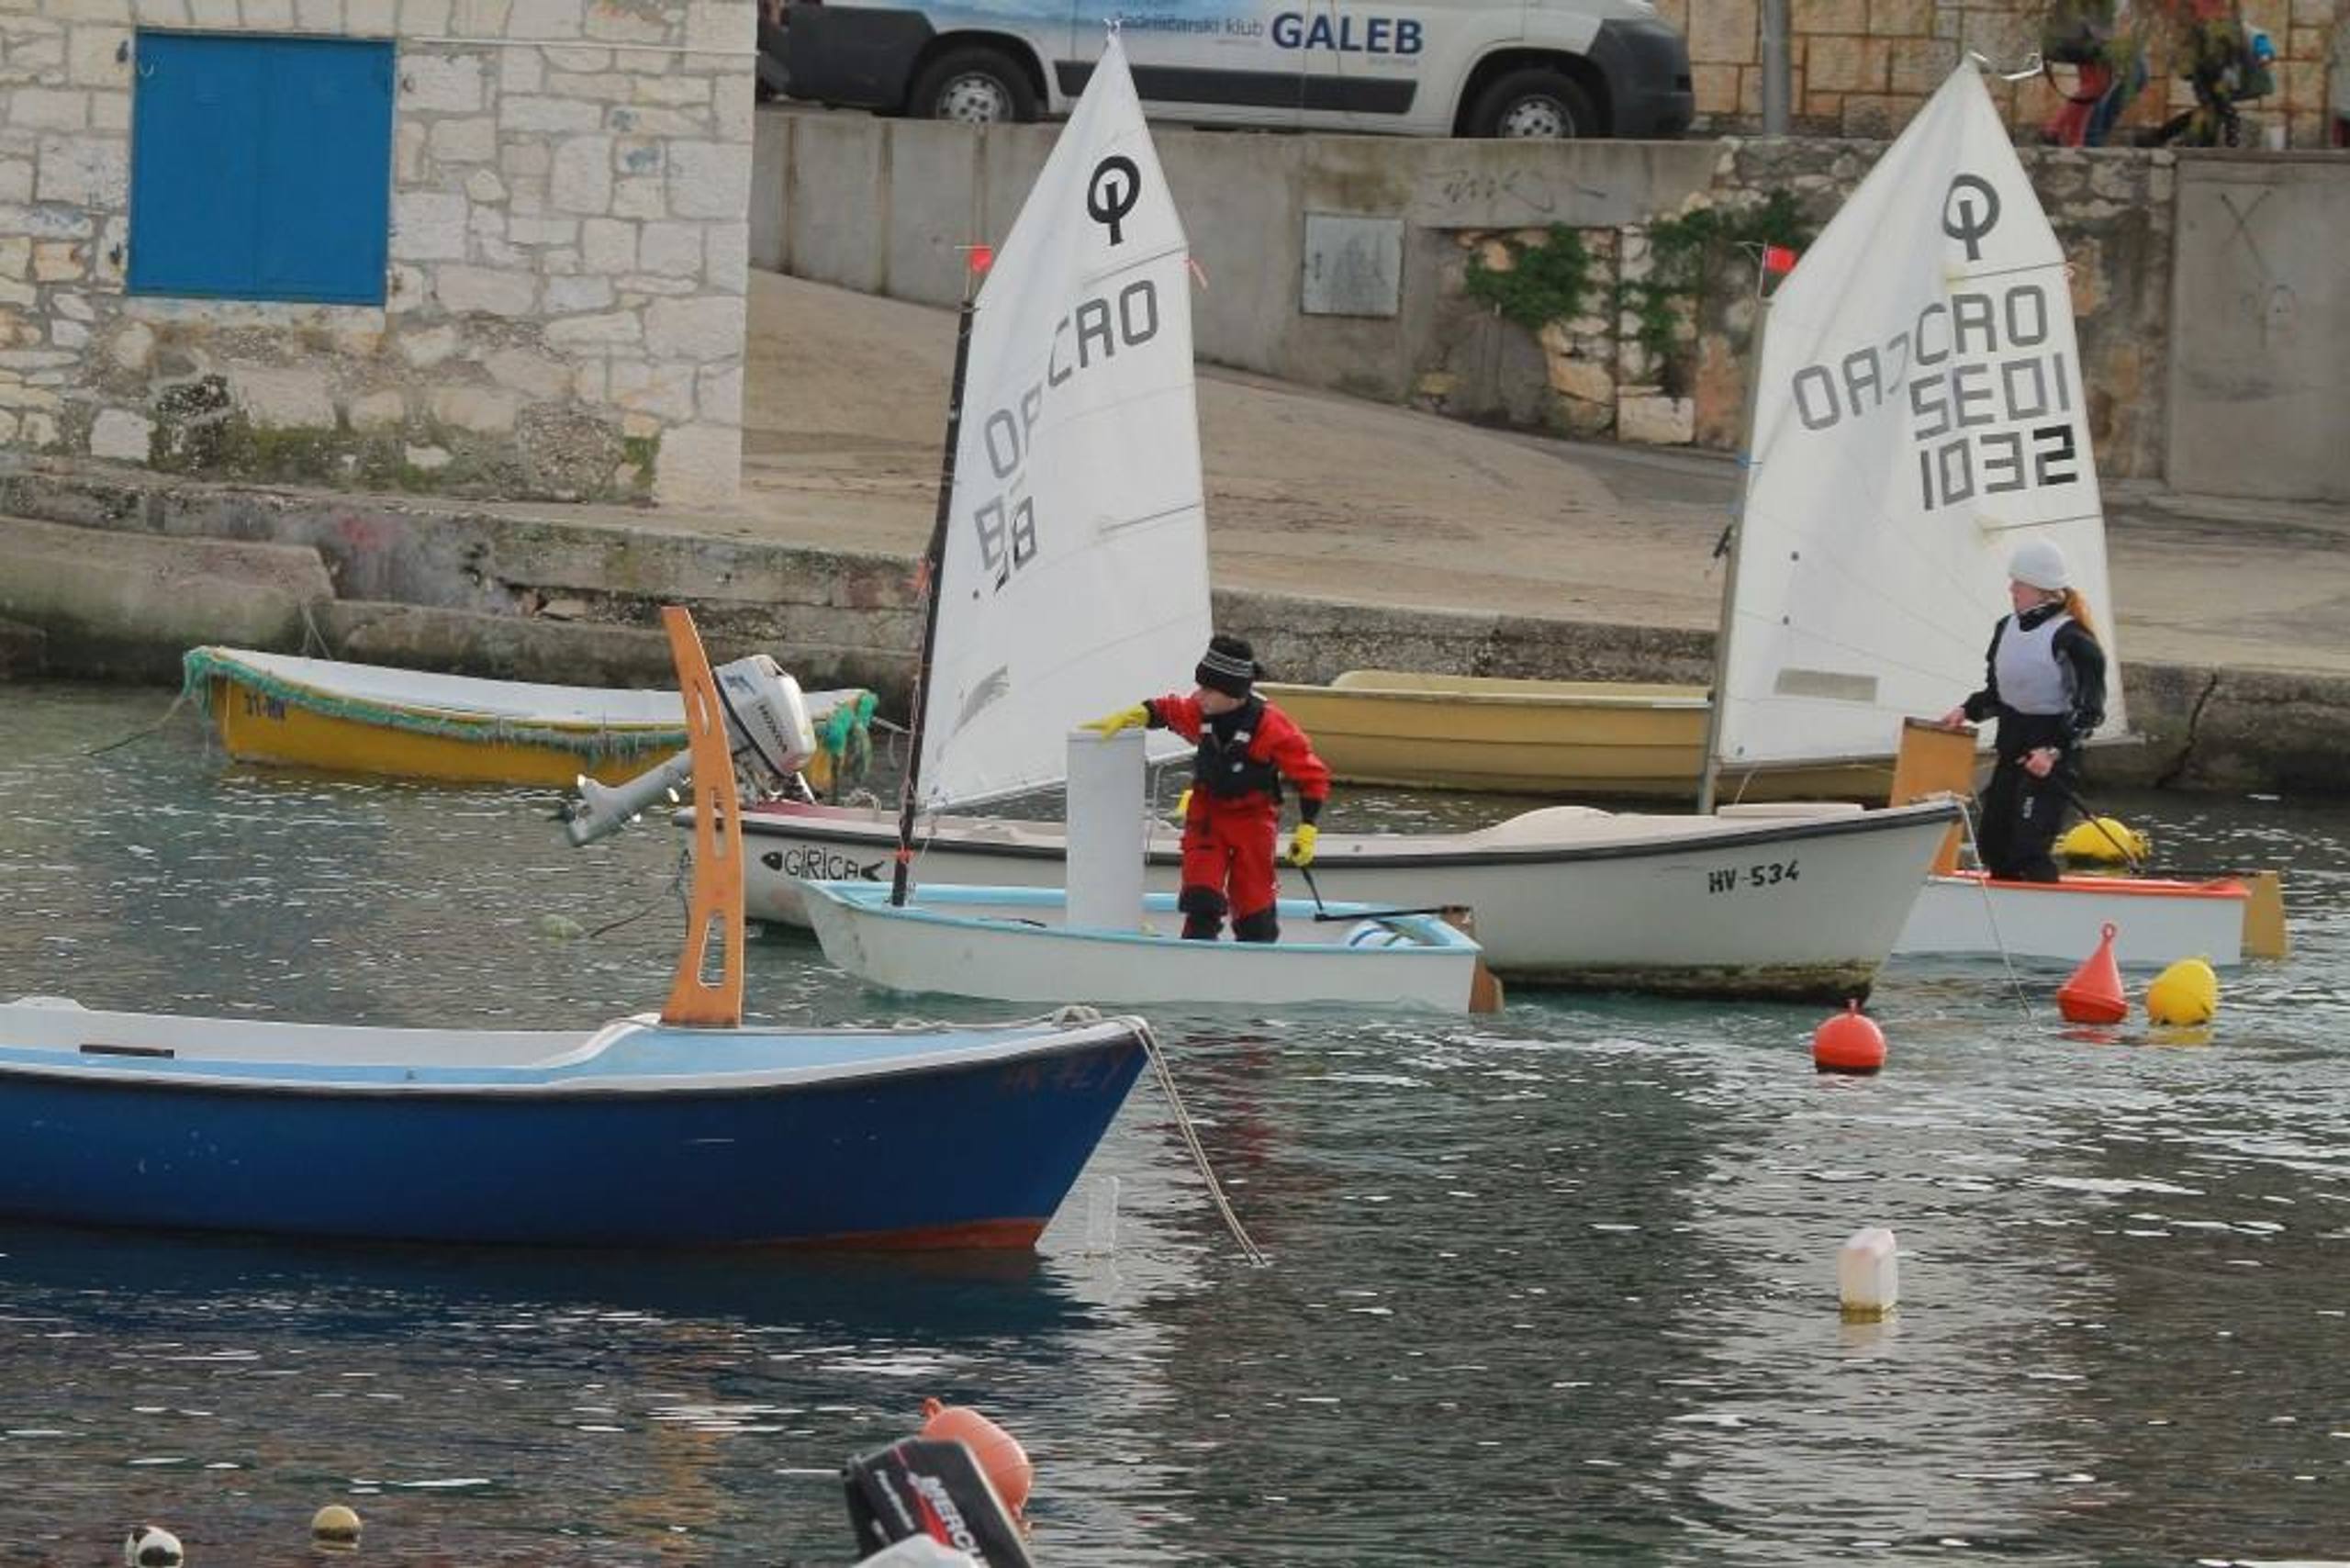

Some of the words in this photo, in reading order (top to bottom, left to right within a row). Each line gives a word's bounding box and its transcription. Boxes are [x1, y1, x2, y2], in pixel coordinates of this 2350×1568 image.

[1271, 12, 1423, 54] GALEB
[1915, 284, 2048, 367] CRO
[1919, 423, 2078, 511] 1032
